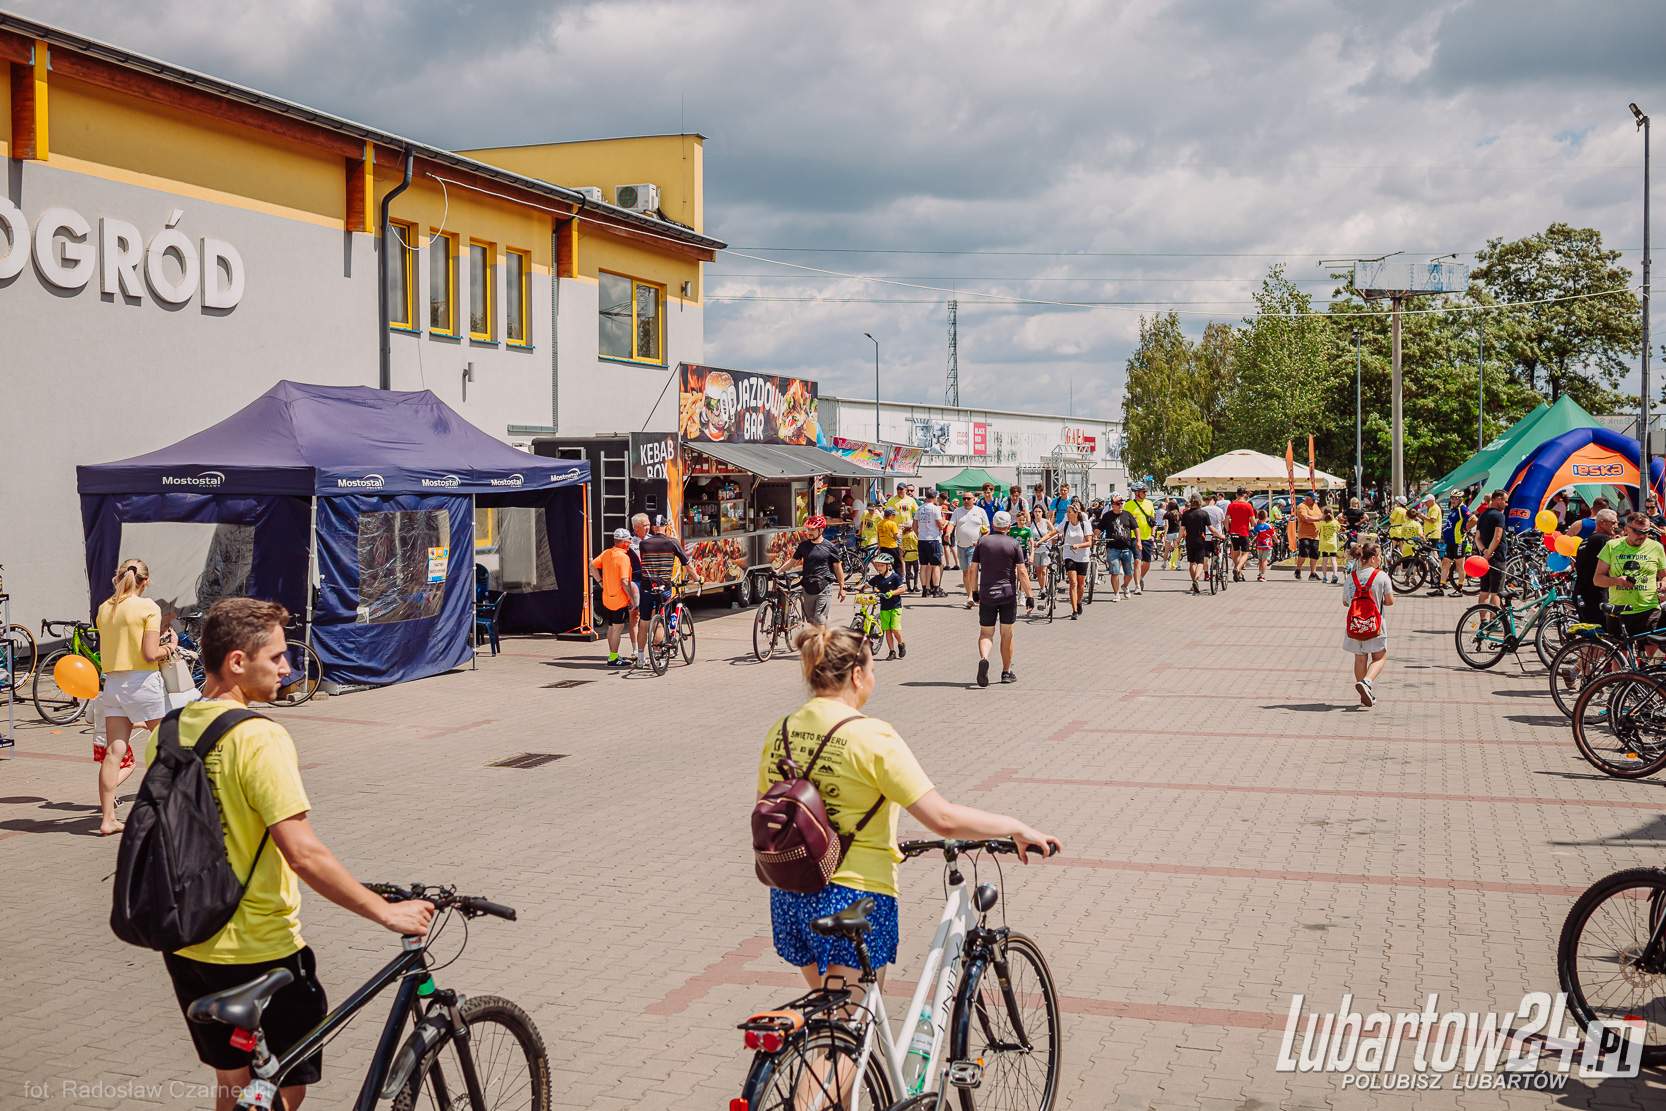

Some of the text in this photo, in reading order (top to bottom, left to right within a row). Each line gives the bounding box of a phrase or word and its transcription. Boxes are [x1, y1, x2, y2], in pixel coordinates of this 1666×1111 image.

[744, 411, 765, 440] BAR
[640, 439, 674, 466] KEBAB
[162, 476, 221, 485] Mostostal
[337, 479, 382, 488] Mostostal
[421, 479, 459, 487] Mostostal
